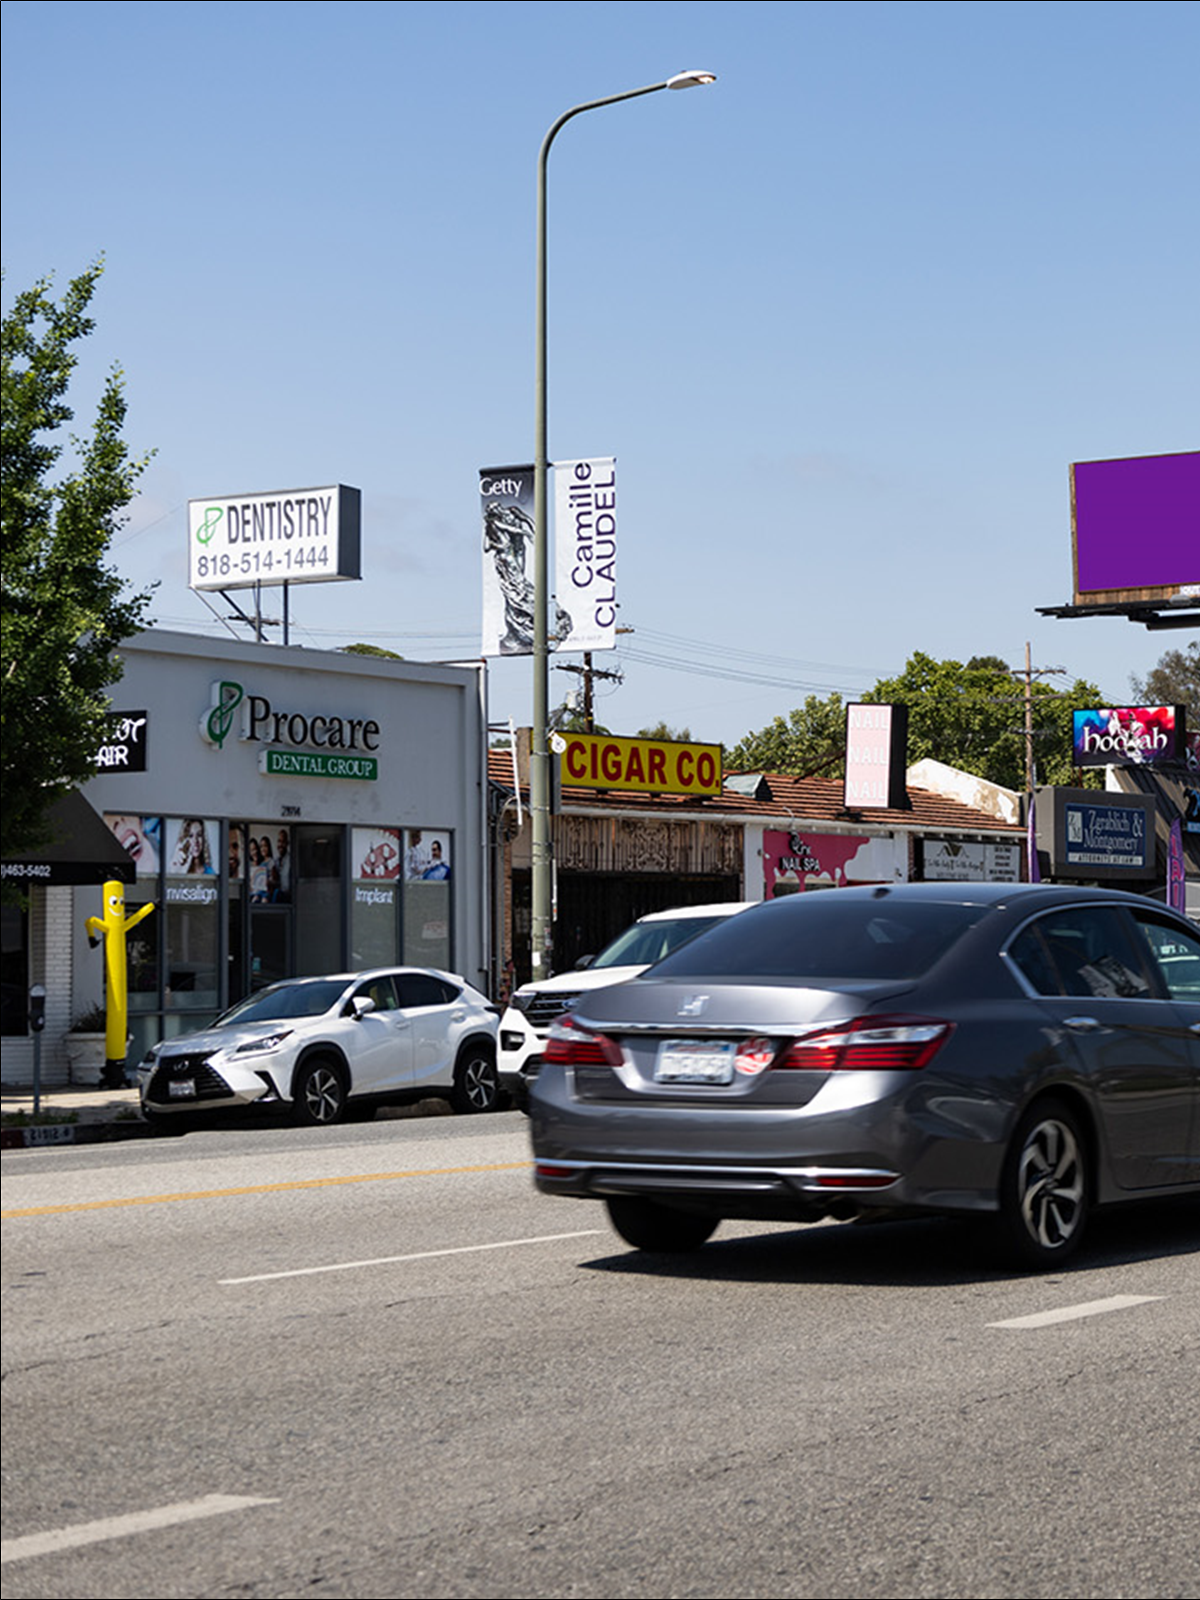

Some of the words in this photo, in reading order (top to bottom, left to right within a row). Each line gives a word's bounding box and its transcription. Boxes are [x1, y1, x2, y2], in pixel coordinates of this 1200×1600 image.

[479, 477, 523, 497] Getty
[227, 496, 332, 544] DENTISTRY
[570, 462, 594, 588] Camille
[197, 545, 329, 577] 818-514-1444
[595, 471, 616, 628] CLAUDEL
[246, 695, 380, 752] Procare
[850, 709, 889, 729] NAIL
[272, 753, 326, 774] DENTAL
[327, 759, 373, 777] GROUP
[566, 740, 668, 786] CIGAR
[676, 750, 720, 789] CO.
[849, 745, 887, 765] NAIL
[848, 781, 886, 801] NAIL
[1132, 813, 1143, 838] &
[1084, 828, 1138, 855] Montgomery
[781, 857, 802, 871] NAIL
[803, 858, 821, 872] SPA
[355, 887, 394, 906] Implant
